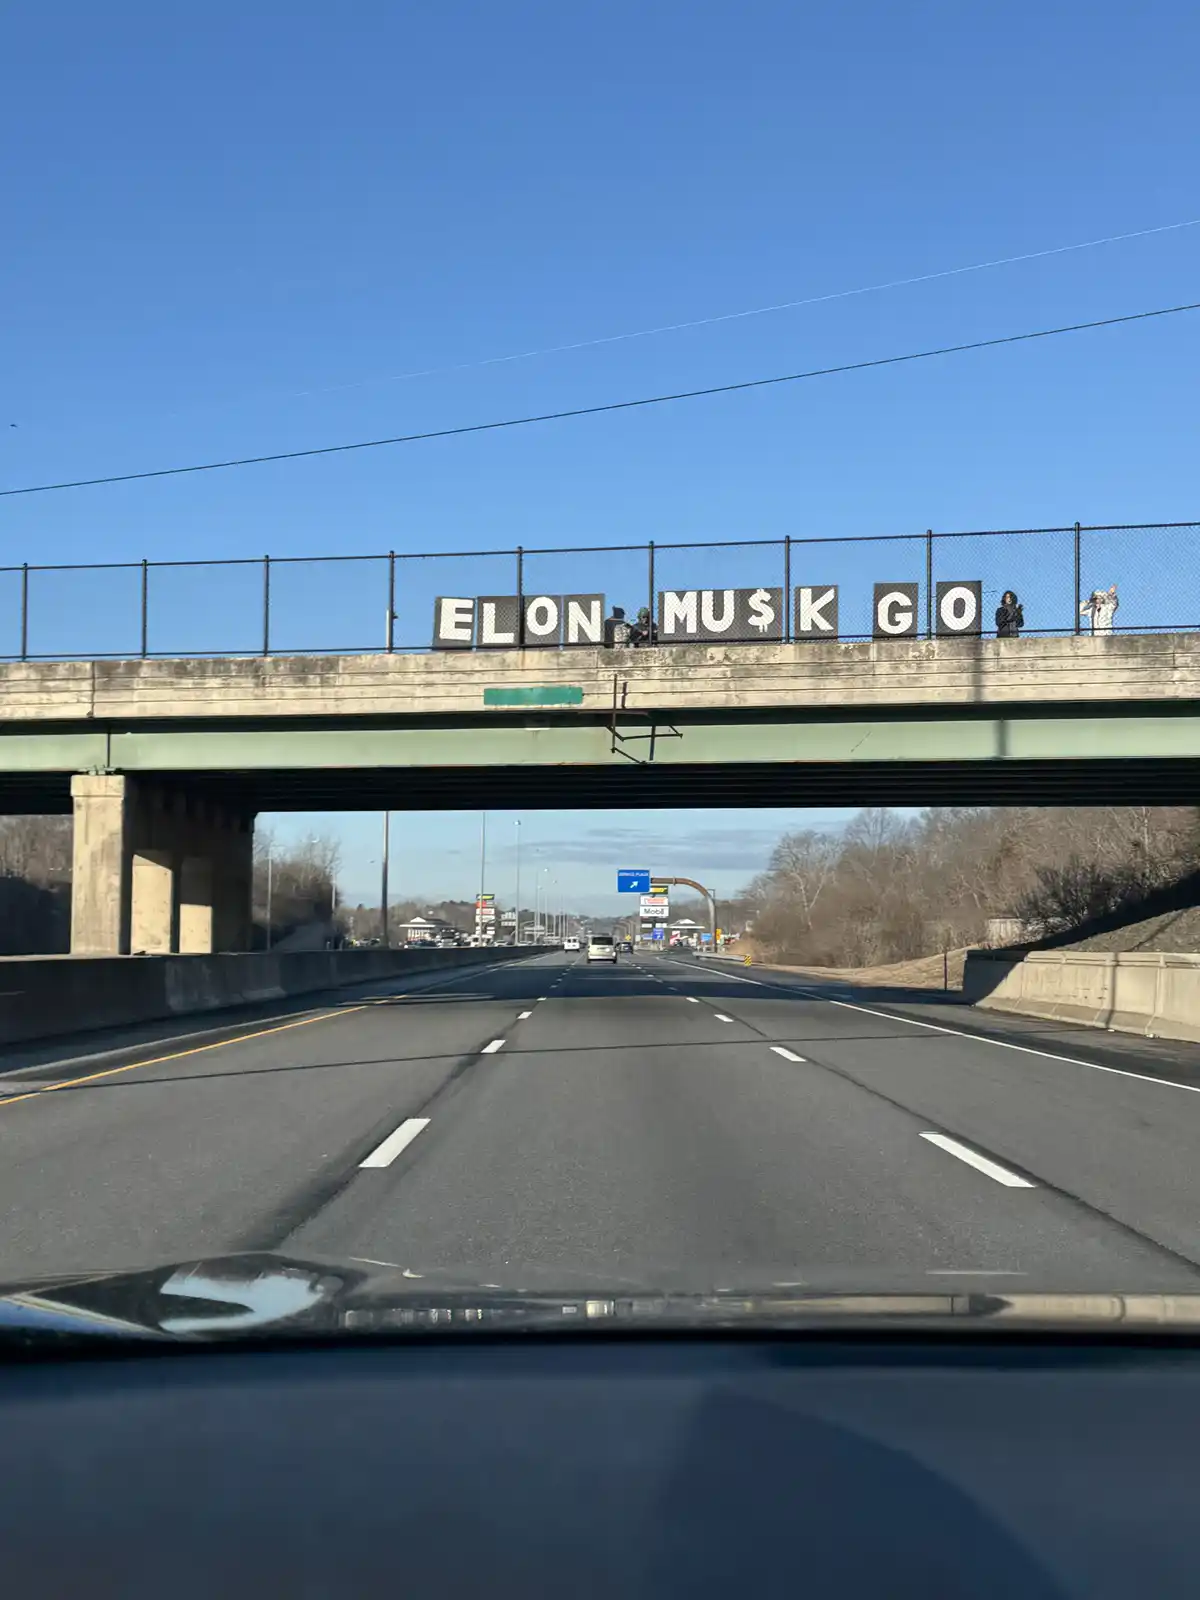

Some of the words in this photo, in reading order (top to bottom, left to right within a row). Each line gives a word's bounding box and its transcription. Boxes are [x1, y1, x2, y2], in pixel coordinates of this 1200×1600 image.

[439, 596, 601, 643] ELON
[663, 587, 835, 634] MU$K
[877, 586, 977, 635] GO
